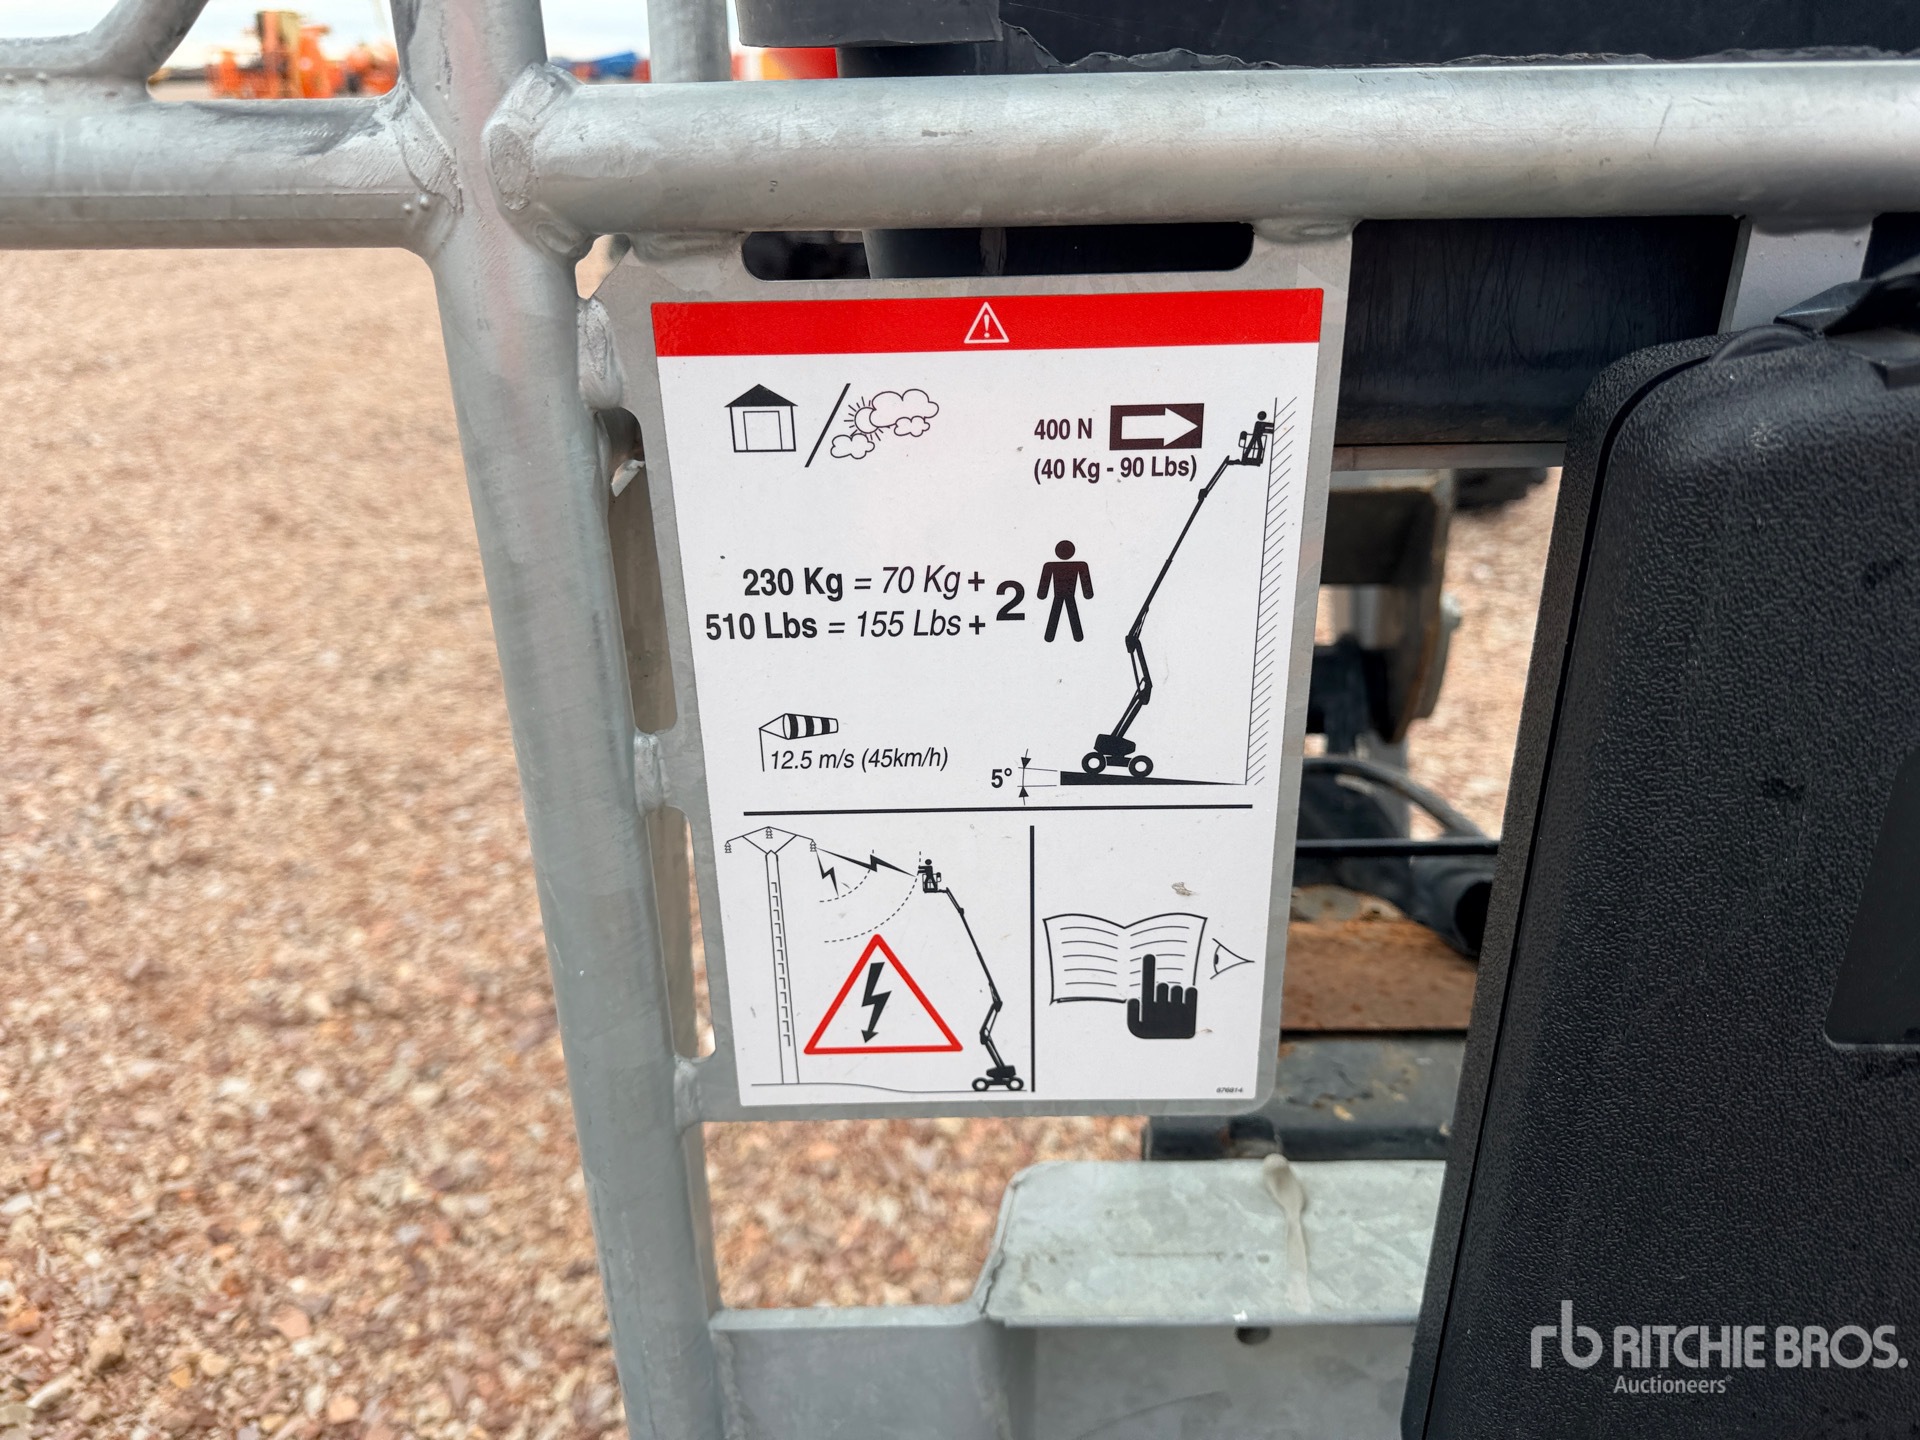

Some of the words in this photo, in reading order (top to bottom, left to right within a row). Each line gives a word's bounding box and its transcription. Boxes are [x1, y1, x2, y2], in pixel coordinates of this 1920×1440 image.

[1033, 418, 1071, 441] 400
[1077, 417, 1093, 440] N
[1033, 458, 1066, 486] (40
[1072, 457, 1101, 484] Kg
[1120, 456, 1145, 478] 90
[1151, 454, 1198, 482] Lbs)
[742, 567, 794, 597] 230
[803, 566, 844, 603] Kg
[853, 577, 872, 590] =
[882, 565, 915, 594] 70
[923, 564, 961, 601] Kg
[967, 571, 986, 592] +
[995, 579, 1026, 622] 2
[705, 612, 756, 641] 510
[764, 611, 818, 639] Lbs
[827, 622, 846, 634] =
[857, 610, 905, 638] 155
[913, 608, 962, 637] Lbs
[968, 614, 986, 636] +
[771, 749, 813, 770] 12.5
[818, 748, 855, 769] m/s
[861, 746, 949, 774] (45km/h)
[990, 767, 1013, 789] 5°
